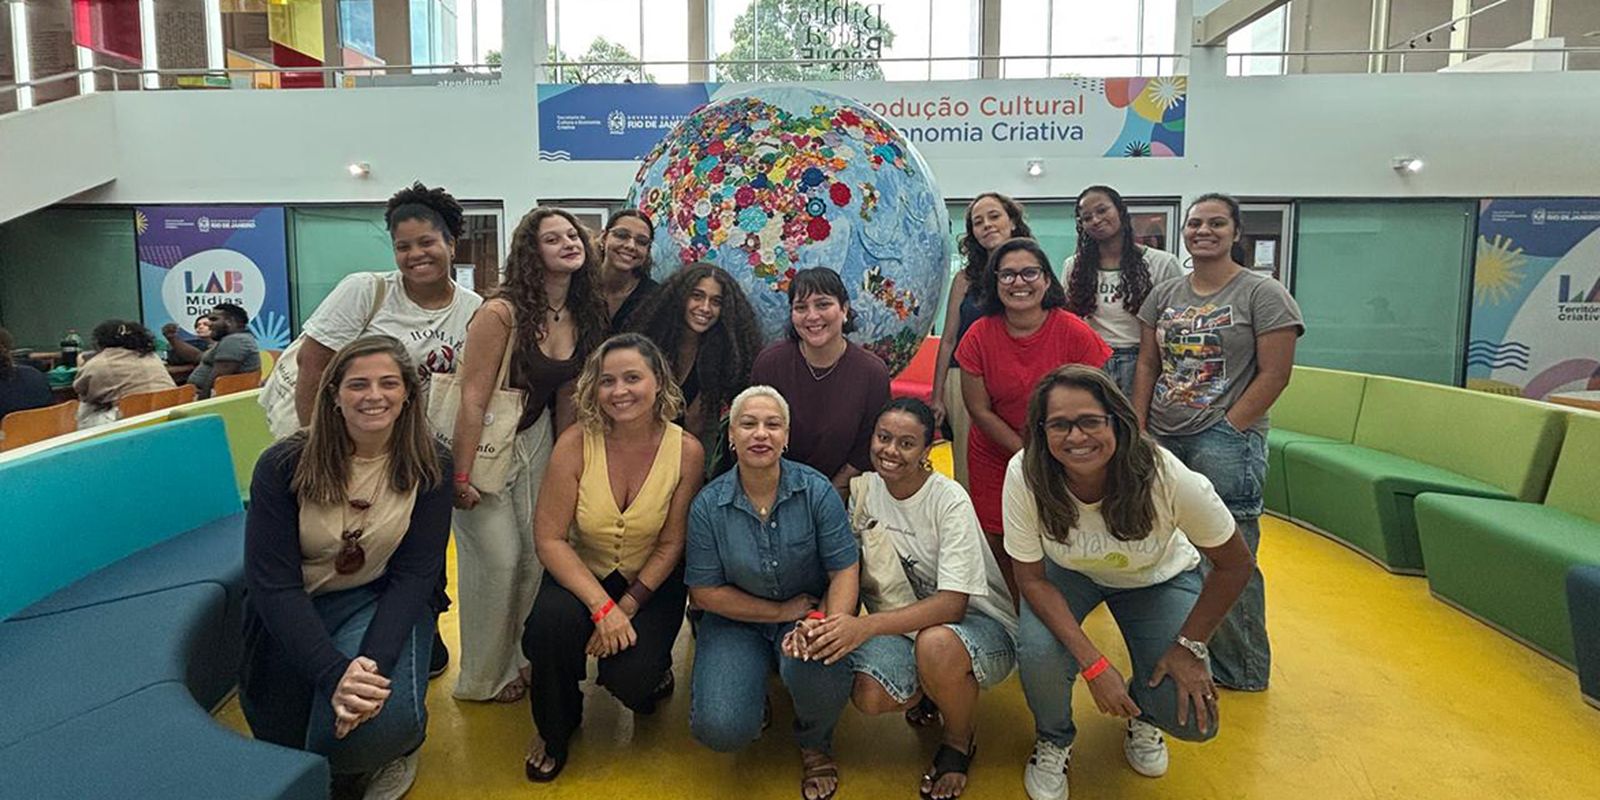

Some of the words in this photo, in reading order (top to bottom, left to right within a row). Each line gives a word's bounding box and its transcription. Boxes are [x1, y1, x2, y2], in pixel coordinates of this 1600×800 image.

[979, 94, 1084, 117] Cultural
[627, 120, 644, 129] RIO
[644, 120, 657, 129] DE
[991, 120, 1084, 141] Criativa
[184, 270, 244, 294] LAB
